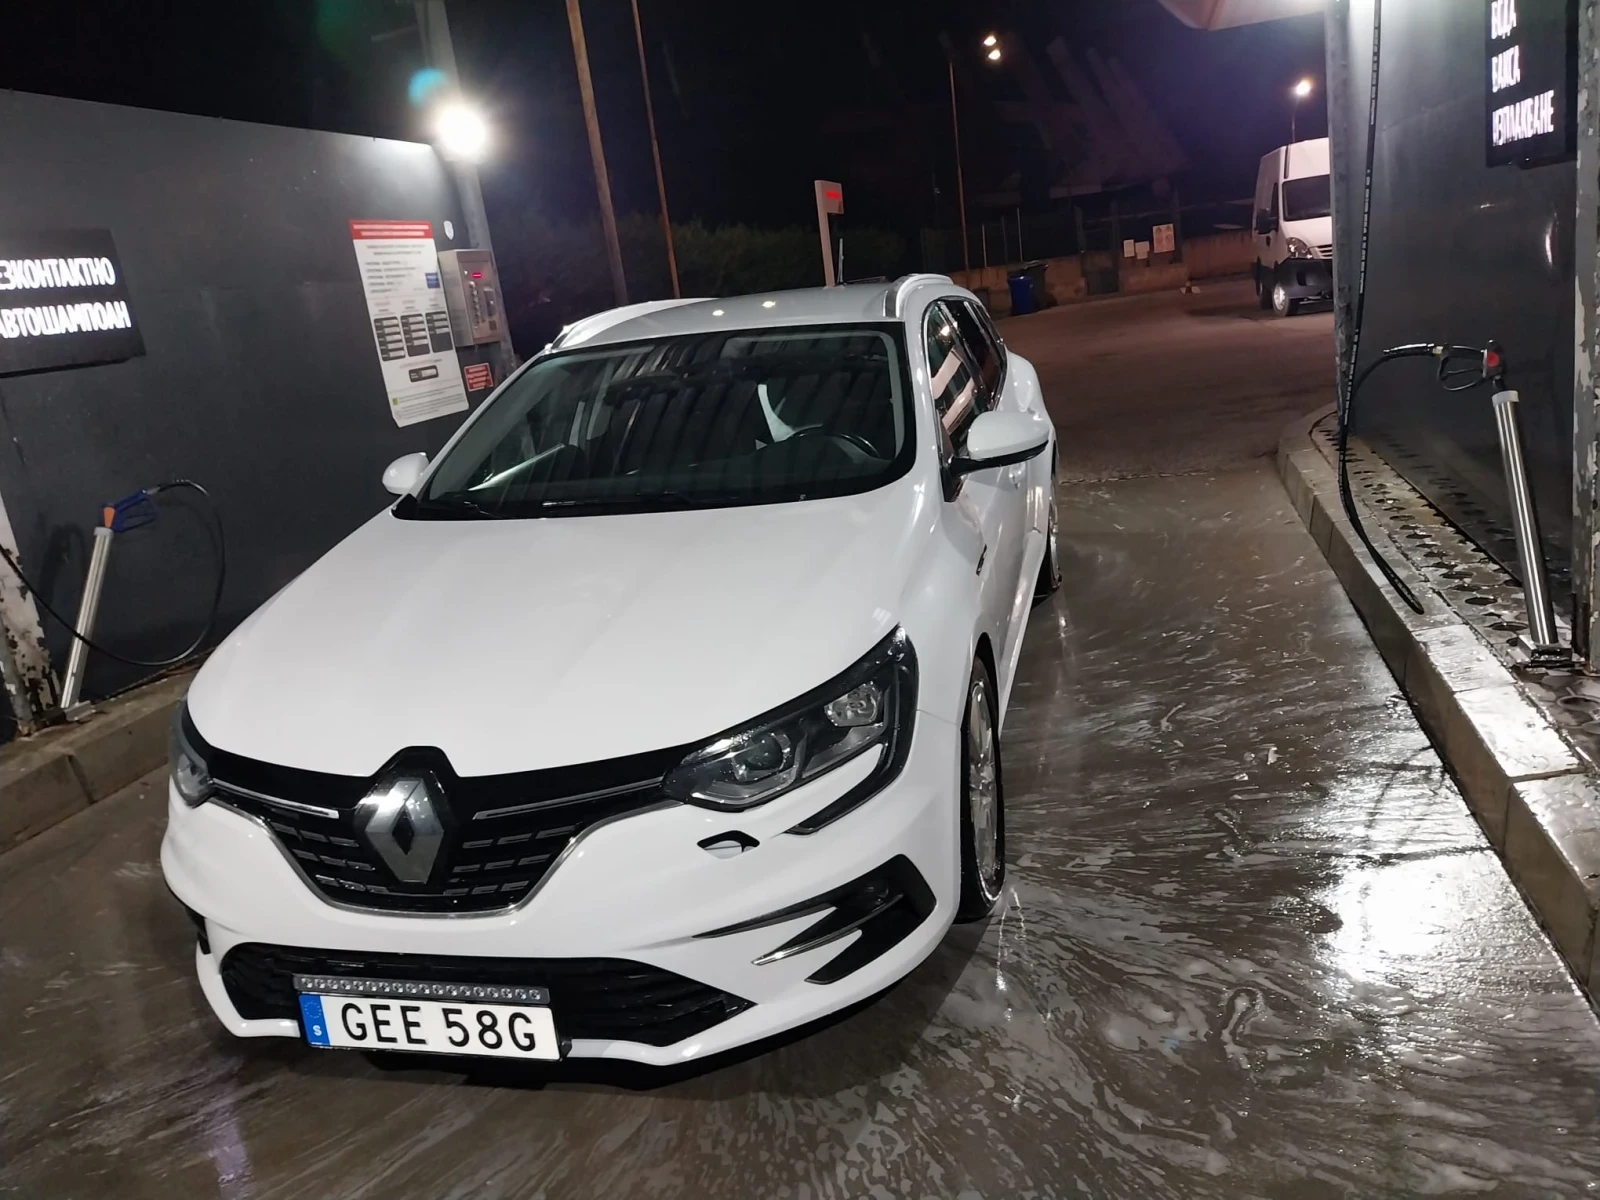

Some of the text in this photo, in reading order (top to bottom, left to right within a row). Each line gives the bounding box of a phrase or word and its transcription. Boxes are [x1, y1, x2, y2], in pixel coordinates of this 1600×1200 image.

[312, 1025, 323, 1037] S
[341, 1002, 536, 1052] GEE 58G
